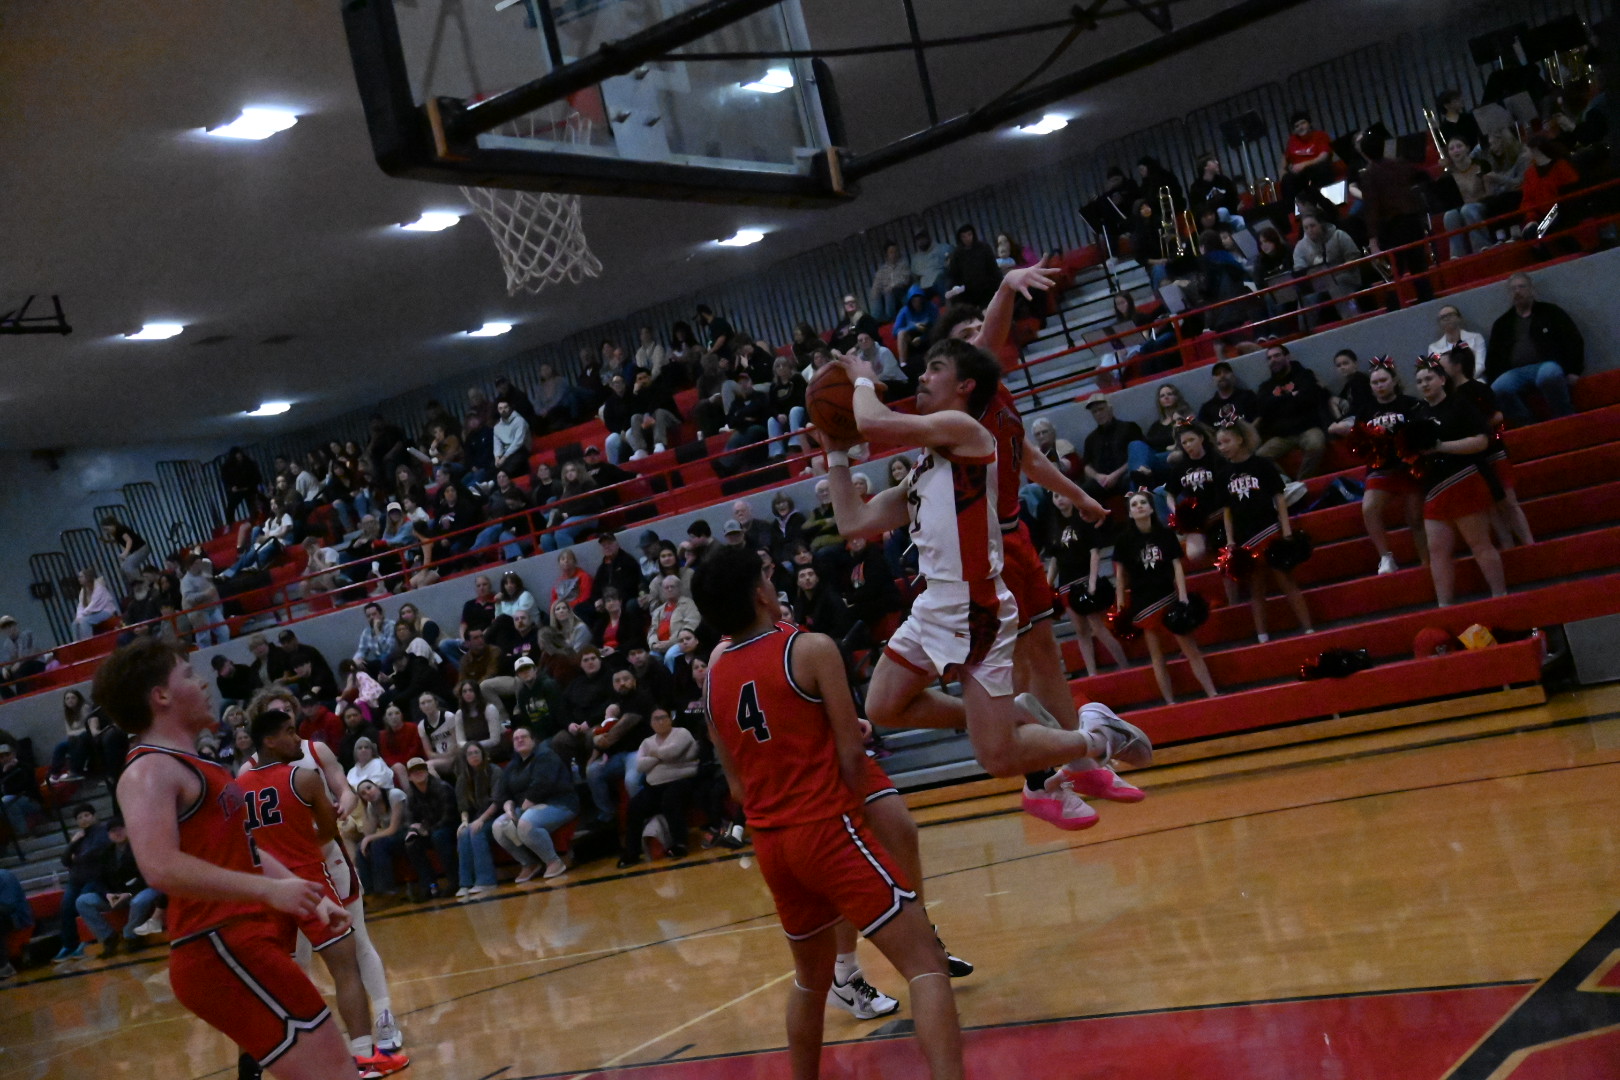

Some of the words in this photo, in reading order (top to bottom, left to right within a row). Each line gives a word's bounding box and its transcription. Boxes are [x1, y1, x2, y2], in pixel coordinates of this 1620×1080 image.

[1180, 469, 1214, 488] CHEER
[736, 680, 772, 743] 4
[244, 786, 283, 830] 12
